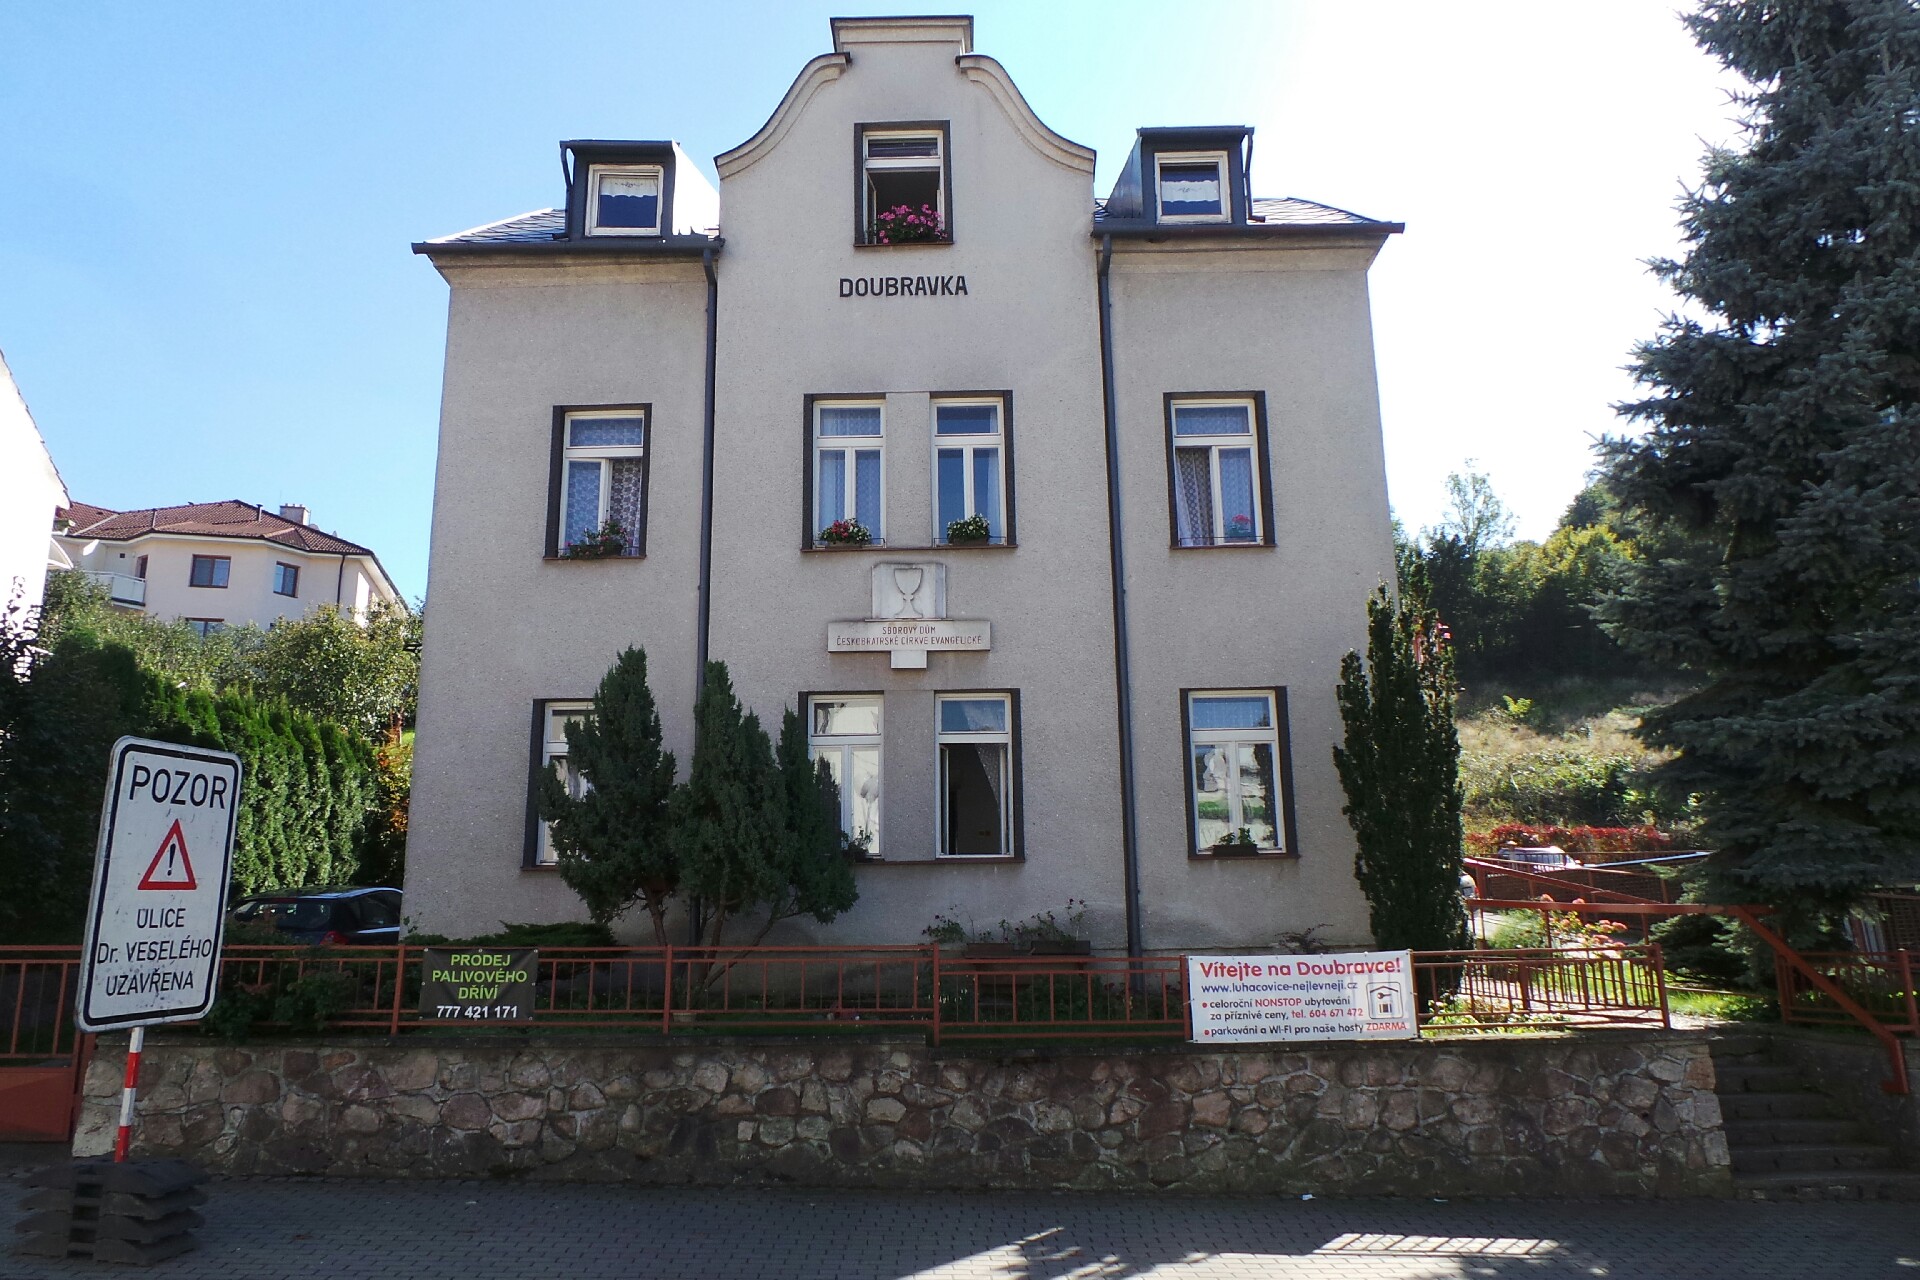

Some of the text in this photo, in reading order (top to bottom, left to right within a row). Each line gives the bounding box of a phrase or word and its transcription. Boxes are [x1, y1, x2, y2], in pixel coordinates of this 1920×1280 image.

[839, 275, 969, 298] DOUBRAVKA
[882, 625, 936, 635] SBOROVÝ DŮM
[901, 636, 929, 645] CÍRKVE
[931, 635, 982, 645] EVANGELICKÉ
[129, 765, 228, 810] POZOR
[136, 907, 186, 929] ULICE
[96, 935, 213, 964] Dr. VESELÉHO
[450, 954, 511, 967] PRODEJ
[432, 968, 528, 983] PALIVOVÉHO
[1200, 957, 1401, 981] Vítejte na Doubravce!
[105, 967, 194, 997] UZAVŘENA
[1201, 980, 1358, 993] www.luhacovice-nejlevneji.cz
[458, 984, 499, 1000] DŘÍVÍ
[1209, 996, 1350, 1009] celoroční NONSTOP ubytování
[436, 1005, 518, 1018] 777 421 171
[1224, 1010, 1262, 1021] příznivé
[1264, 1011, 1289, 1020] ceny,
[1291, 1009, 1307, 1018] tel.
[1309, 1009, 1327, 1018] 604
[1329, 1008, 1344, 1017] 671
[1346, 1007, 1364, 1017] 472
[1211, 1025, 1258, 1037] parkování
[1269, 1024, 1292, 1034] WI-FI
[1294, 1026, 1310, 1036] pro
[1313, 1023, 1336, 1034] naše
[1338, 1023, 1364, 1034] hosty
[1366, 1021, 1407, 1031] ZDARMA
